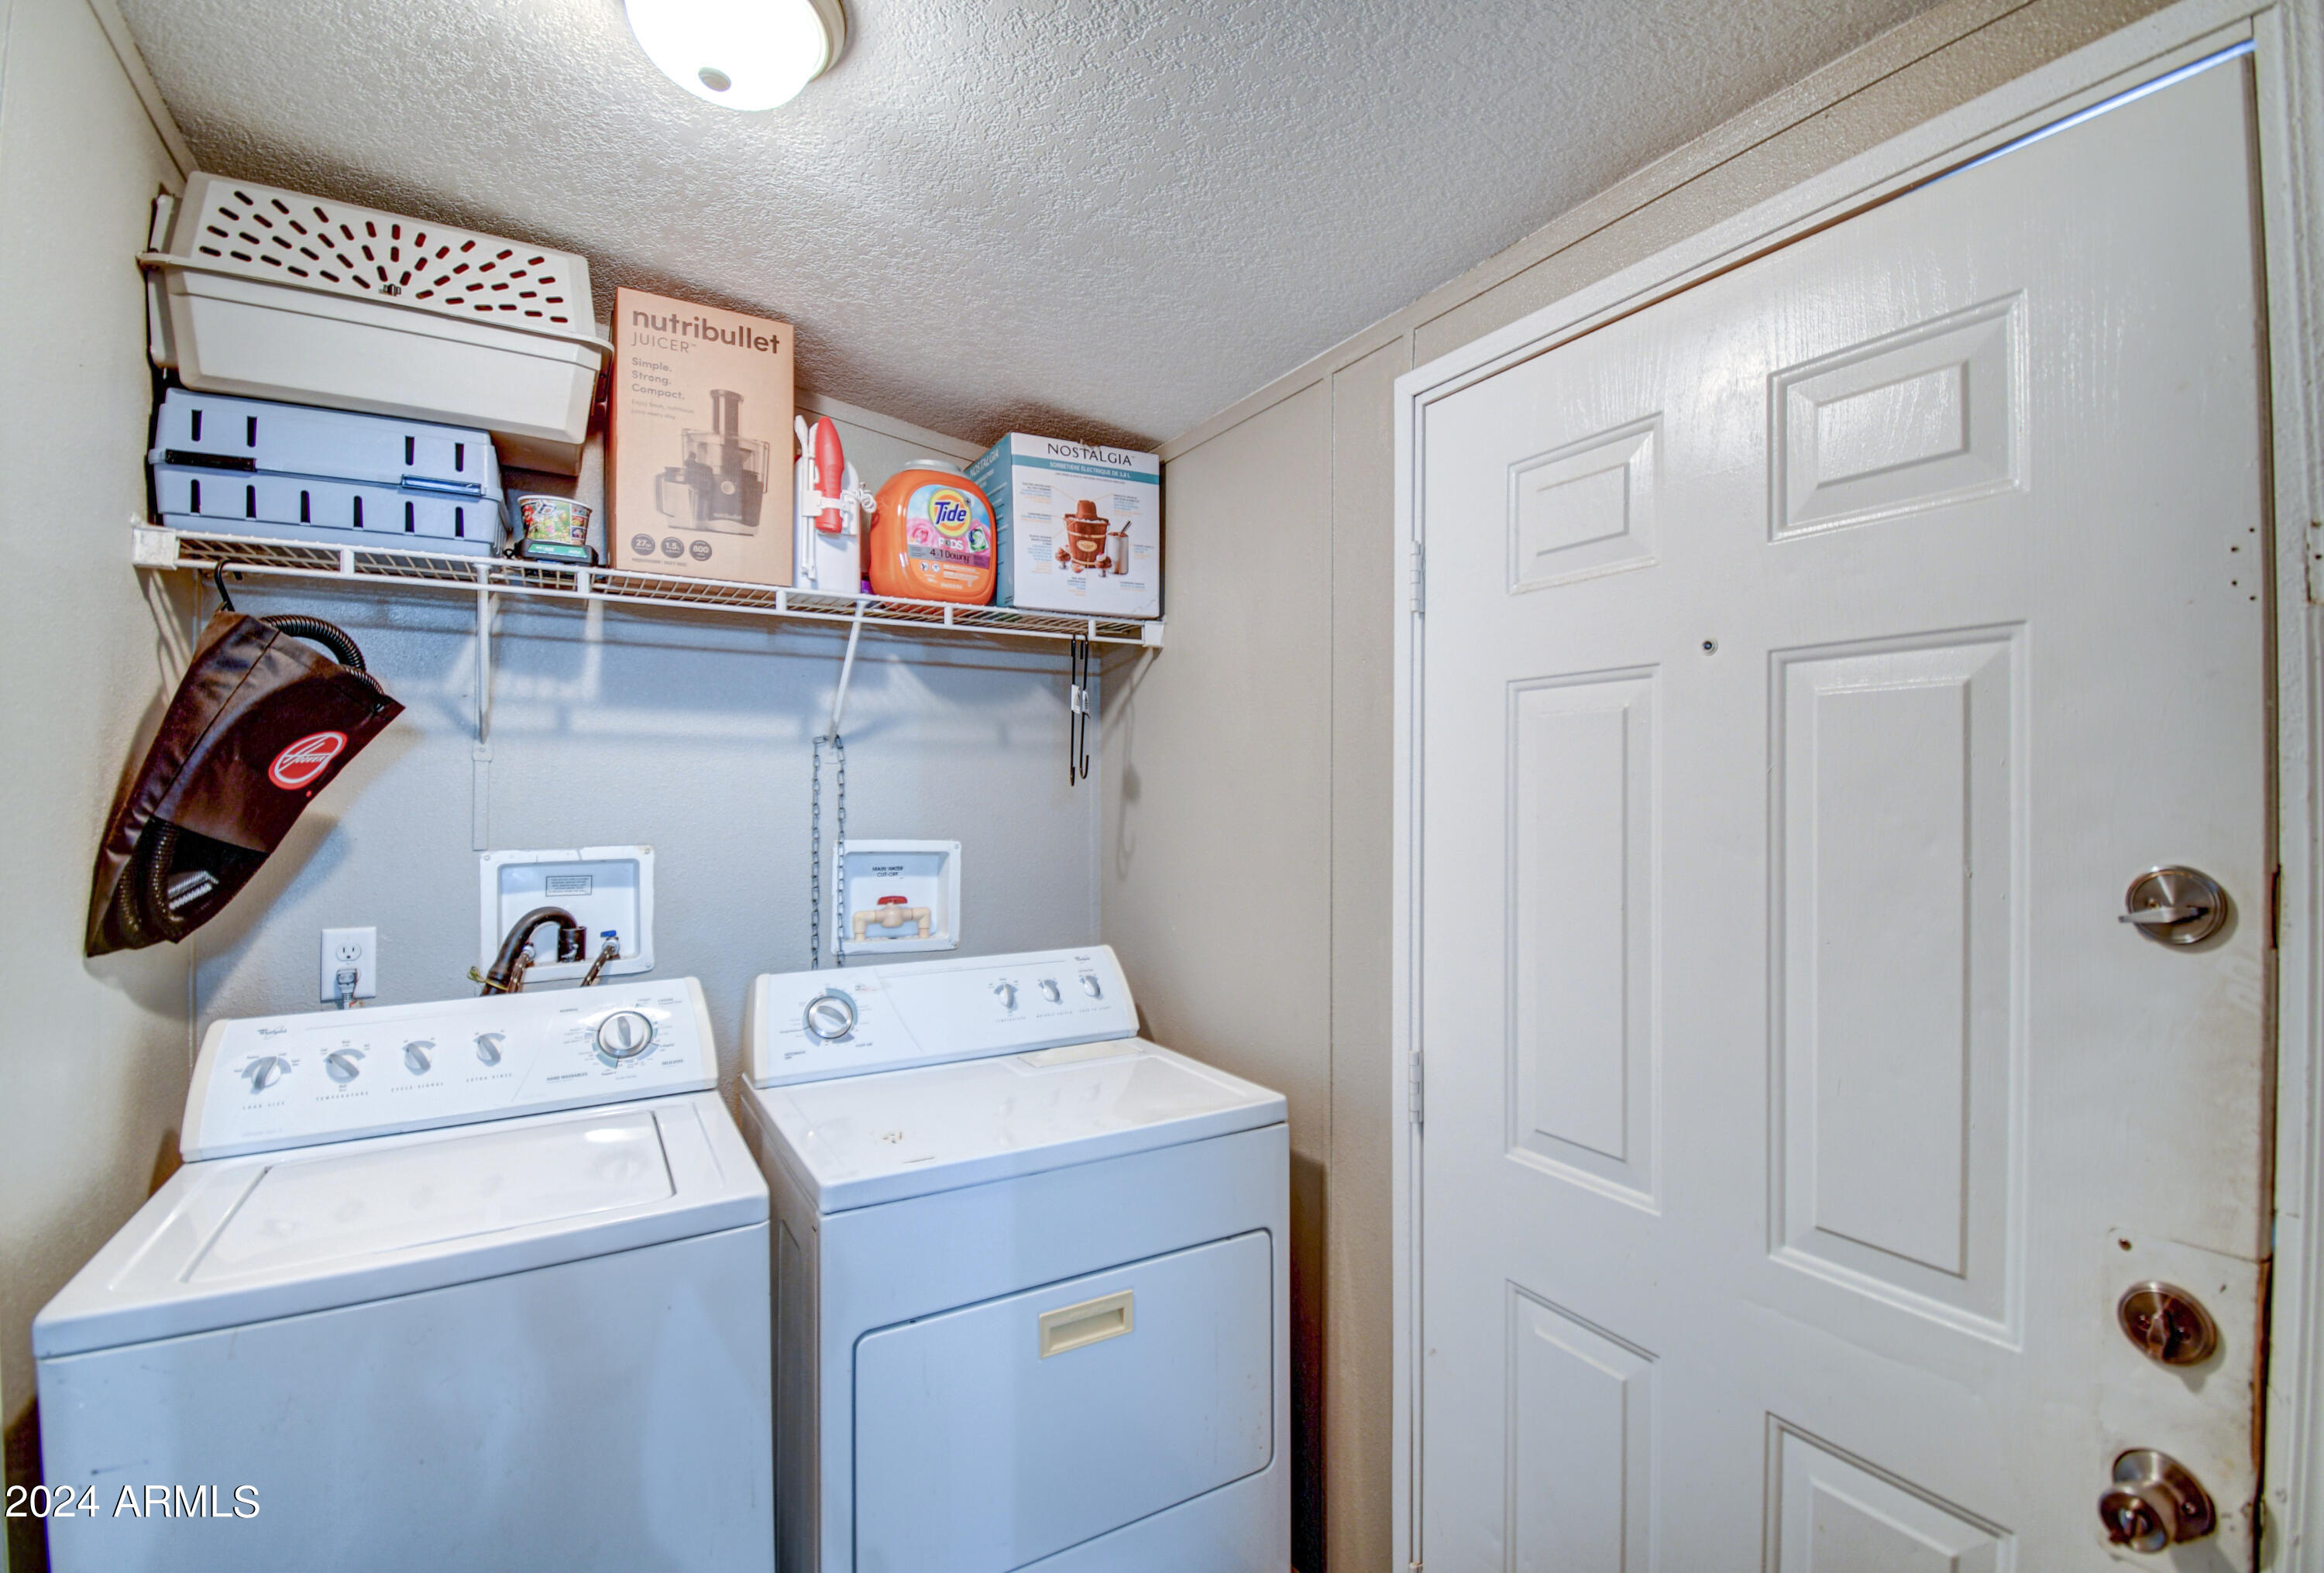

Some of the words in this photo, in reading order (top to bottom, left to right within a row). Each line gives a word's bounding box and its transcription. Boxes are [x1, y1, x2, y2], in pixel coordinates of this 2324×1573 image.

[632, 310, 780, 355] nutribullet
[631, 357, 672, 372] Simple.
[631, 370, 672, 386] Strong.
[631, 383, 686, 400] Compact.
[1047, 443, 1132, 466] NOSTALGIA
[933, 500, 968, 525] Tide
[944, 551, 970, 565] Downy
